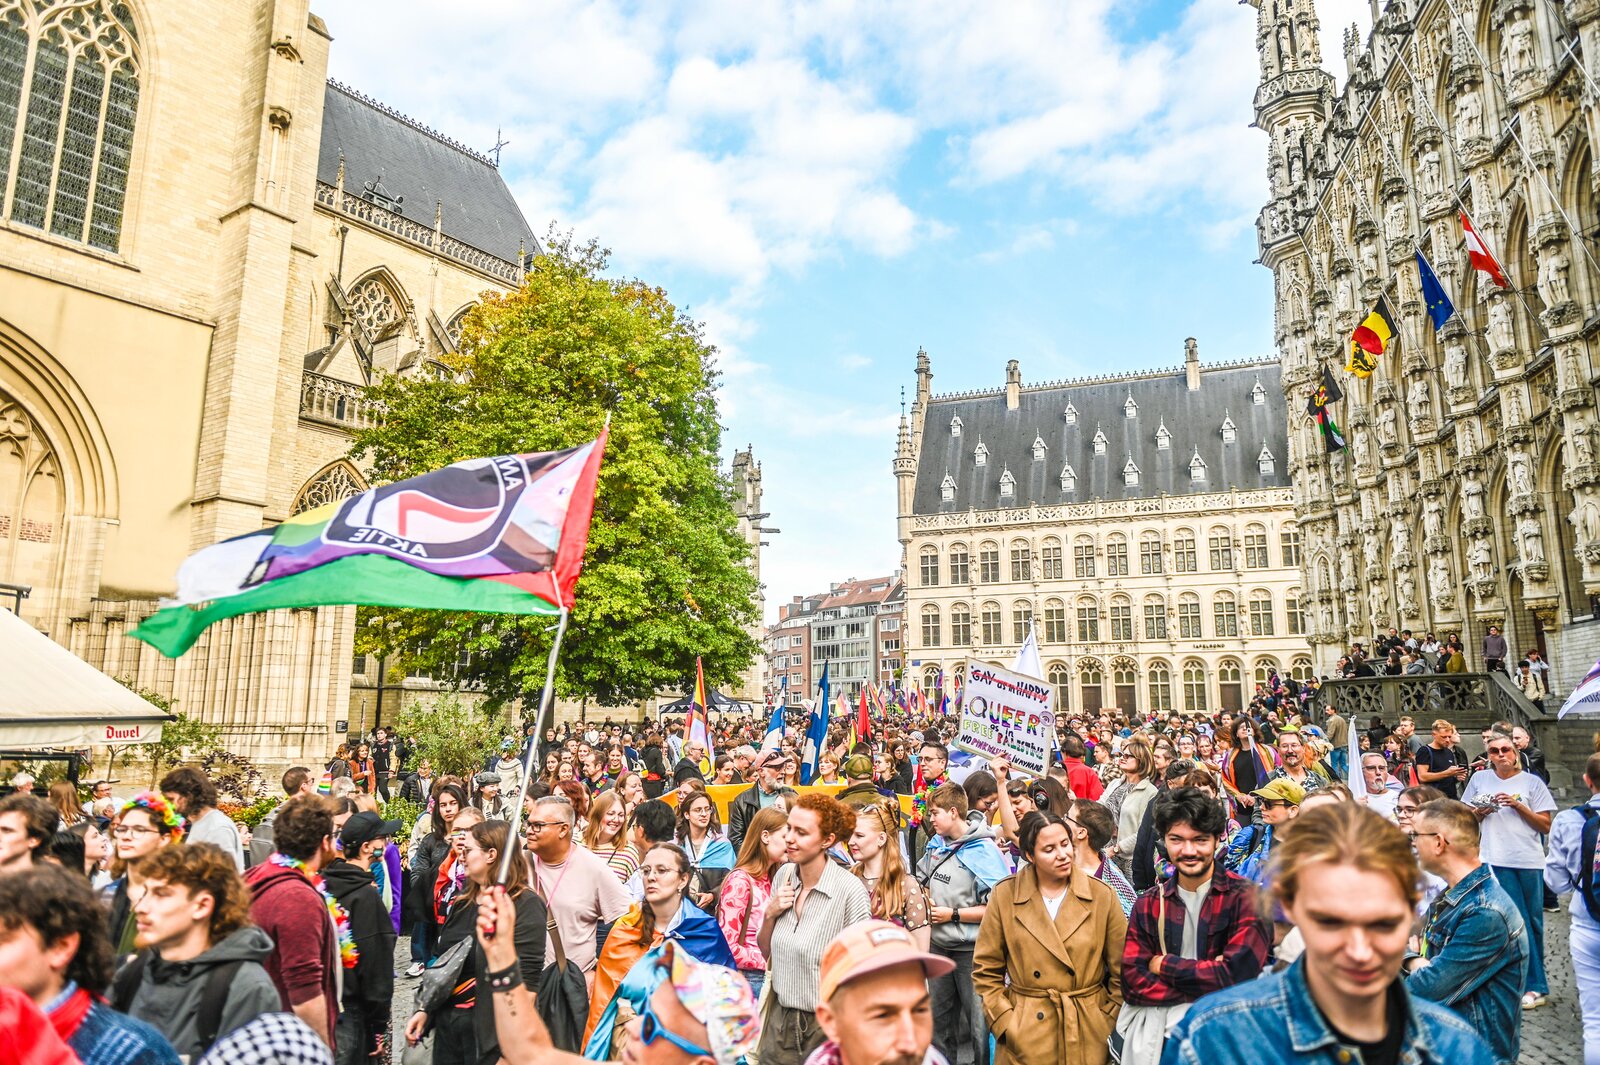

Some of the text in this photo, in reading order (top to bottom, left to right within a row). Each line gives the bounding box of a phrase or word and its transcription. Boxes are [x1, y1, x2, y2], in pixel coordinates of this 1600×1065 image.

[972, 669, 995, 685] GAY
[1016, 681, 1049, 703] HAPPY
[970, 696, 1040, 735] QUEER
[106, 725, 139, 739] Duvel
[963, 719, 993, 739] FREE
[990, 724, 1014, 737] as in
[960, 734, 972, 744] NO
[971, 737, 1012, 760] PINKWASNG
[934, 871, 951, 882] bold
